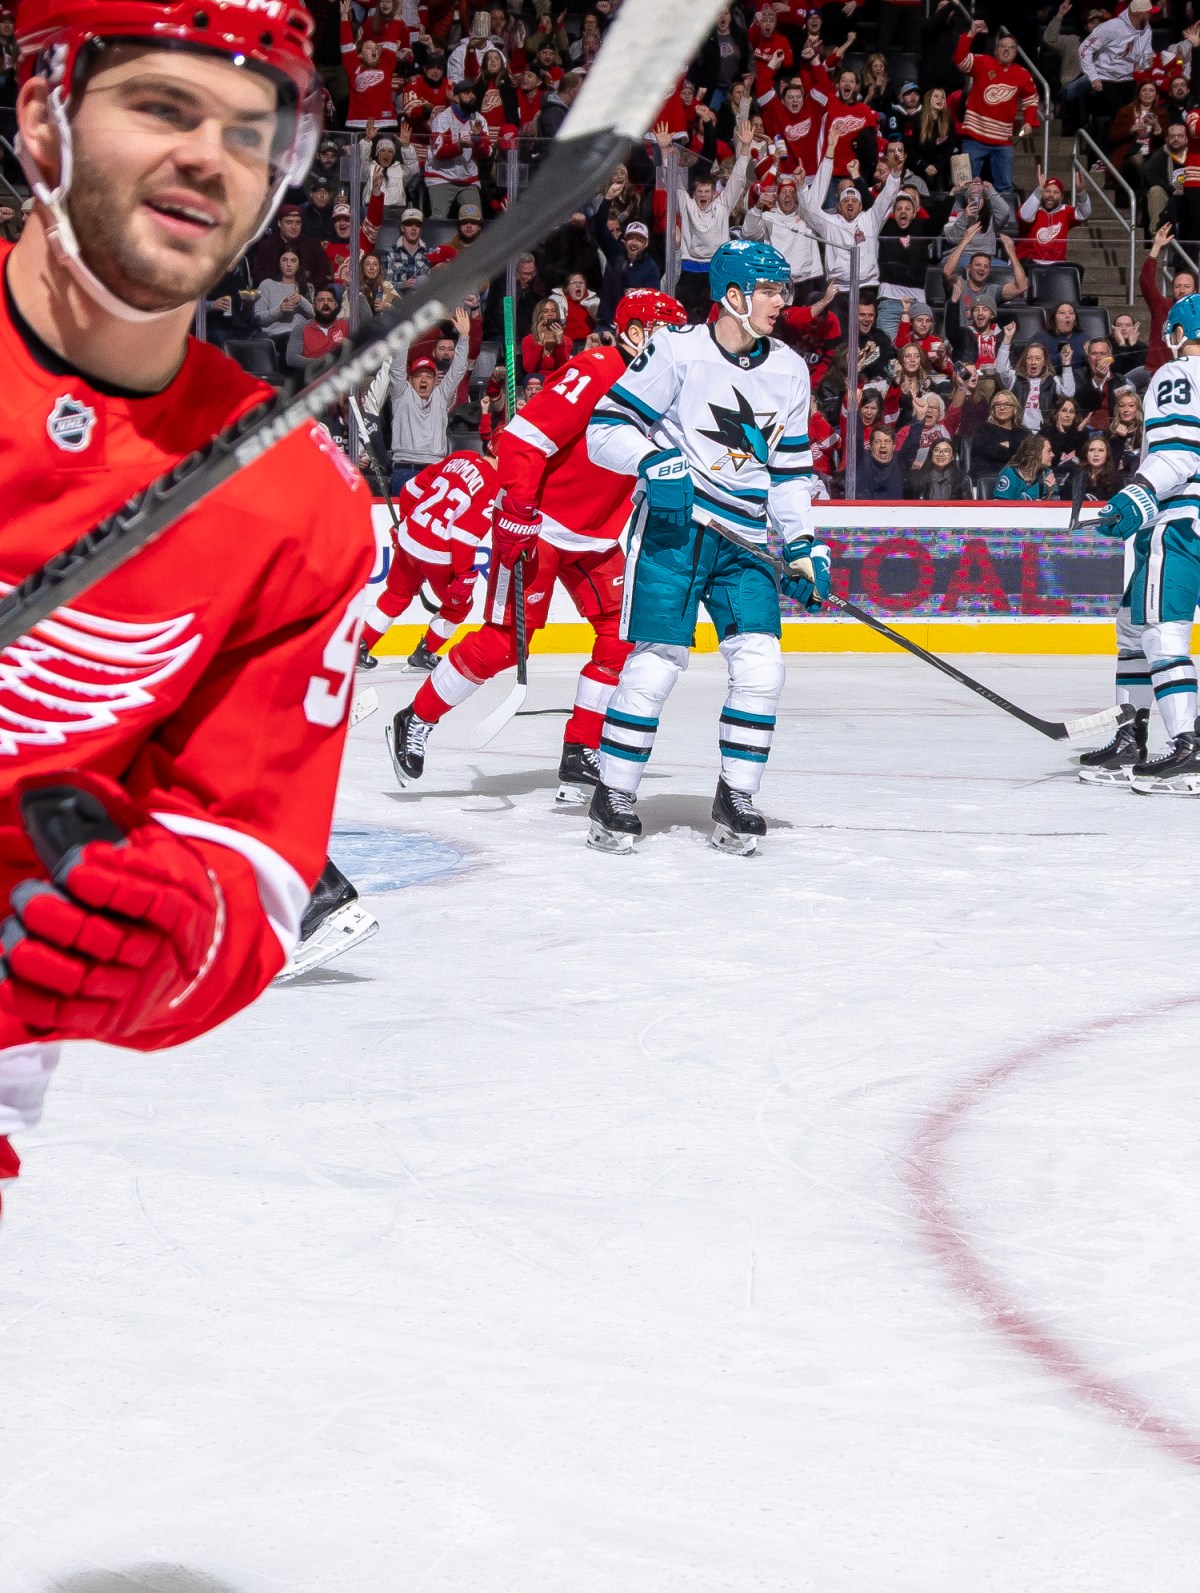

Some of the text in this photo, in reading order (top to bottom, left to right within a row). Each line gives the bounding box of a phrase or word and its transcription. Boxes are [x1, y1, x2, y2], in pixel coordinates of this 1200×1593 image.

[730, 241, 750, 250] SAP
[551, 368, 592, 405] 21
[1157, 377, 1193, 406] 23
[442, 458, 485, 497] RAYMOND
[411, 475, 472, 541] 23
